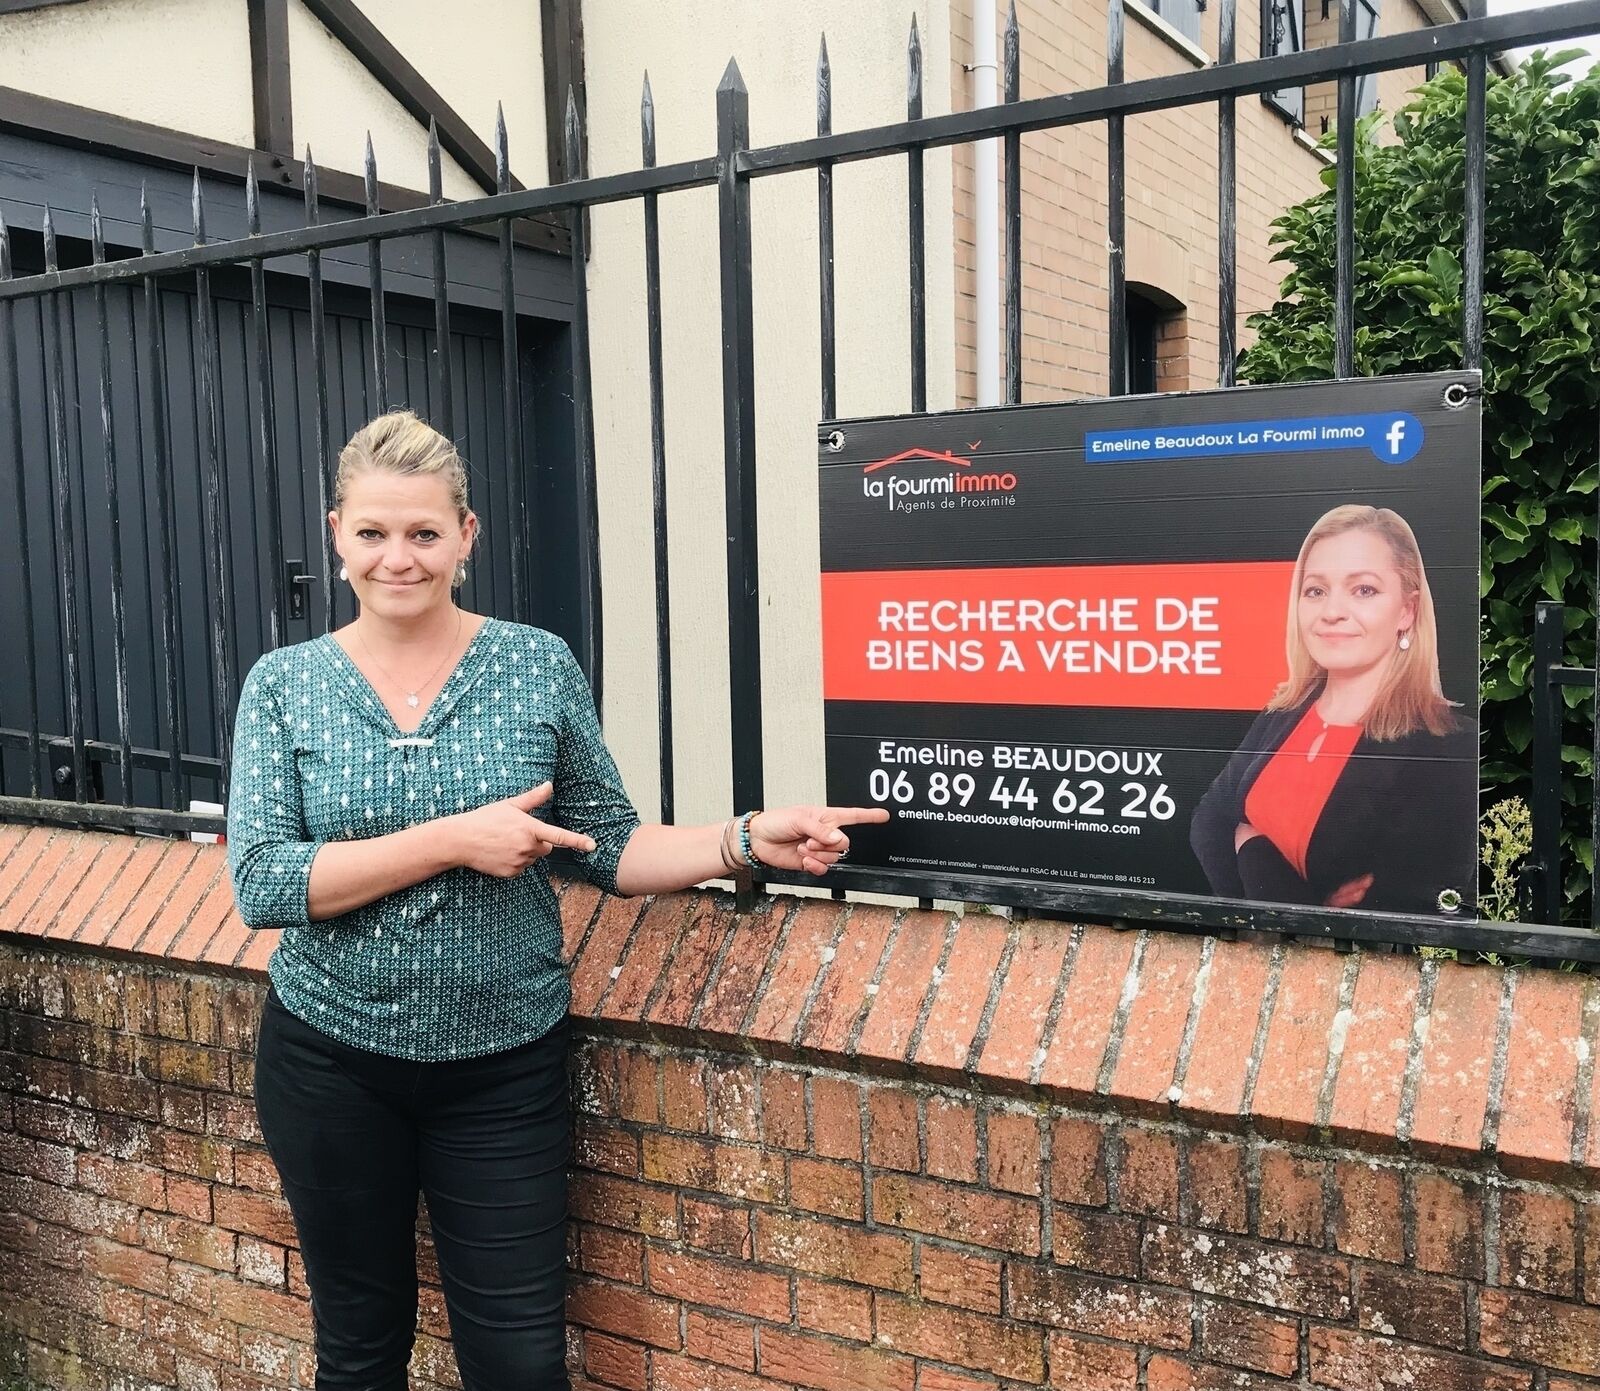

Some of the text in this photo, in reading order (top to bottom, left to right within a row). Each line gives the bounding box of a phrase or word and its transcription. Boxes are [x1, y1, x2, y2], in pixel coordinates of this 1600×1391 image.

[1092, 426, 1365, 453] Emeline Beaudoux La Fourmi immo
[897, 494, 1016, 514] Agents de Proximité
[878, 597, 1219, 633] RECHERCHE DE
[866, 640, 1222, 675] BIENS A VENDRE
[878, 741, 1163, 776] Emeline BEAUDOUX
[869, 769, 1176, 821] 06 89 44 62 26
[898, 808, 1141, 835] emeline.beaudoux@lafourmi-immo.com
[888, 855, 906, 863] Agent
[906, 856, 939, 865] commercial
[948, 860, 977, 869] immobilier
[1030, 867, 1050, 875] RSAC
[1060, 869, 1079, 878] LILLE
[1089, 873, 1114, 881] numéro
[1114, 874, 1128, 882] 888
[1128, 875, 1142, 883] 415
